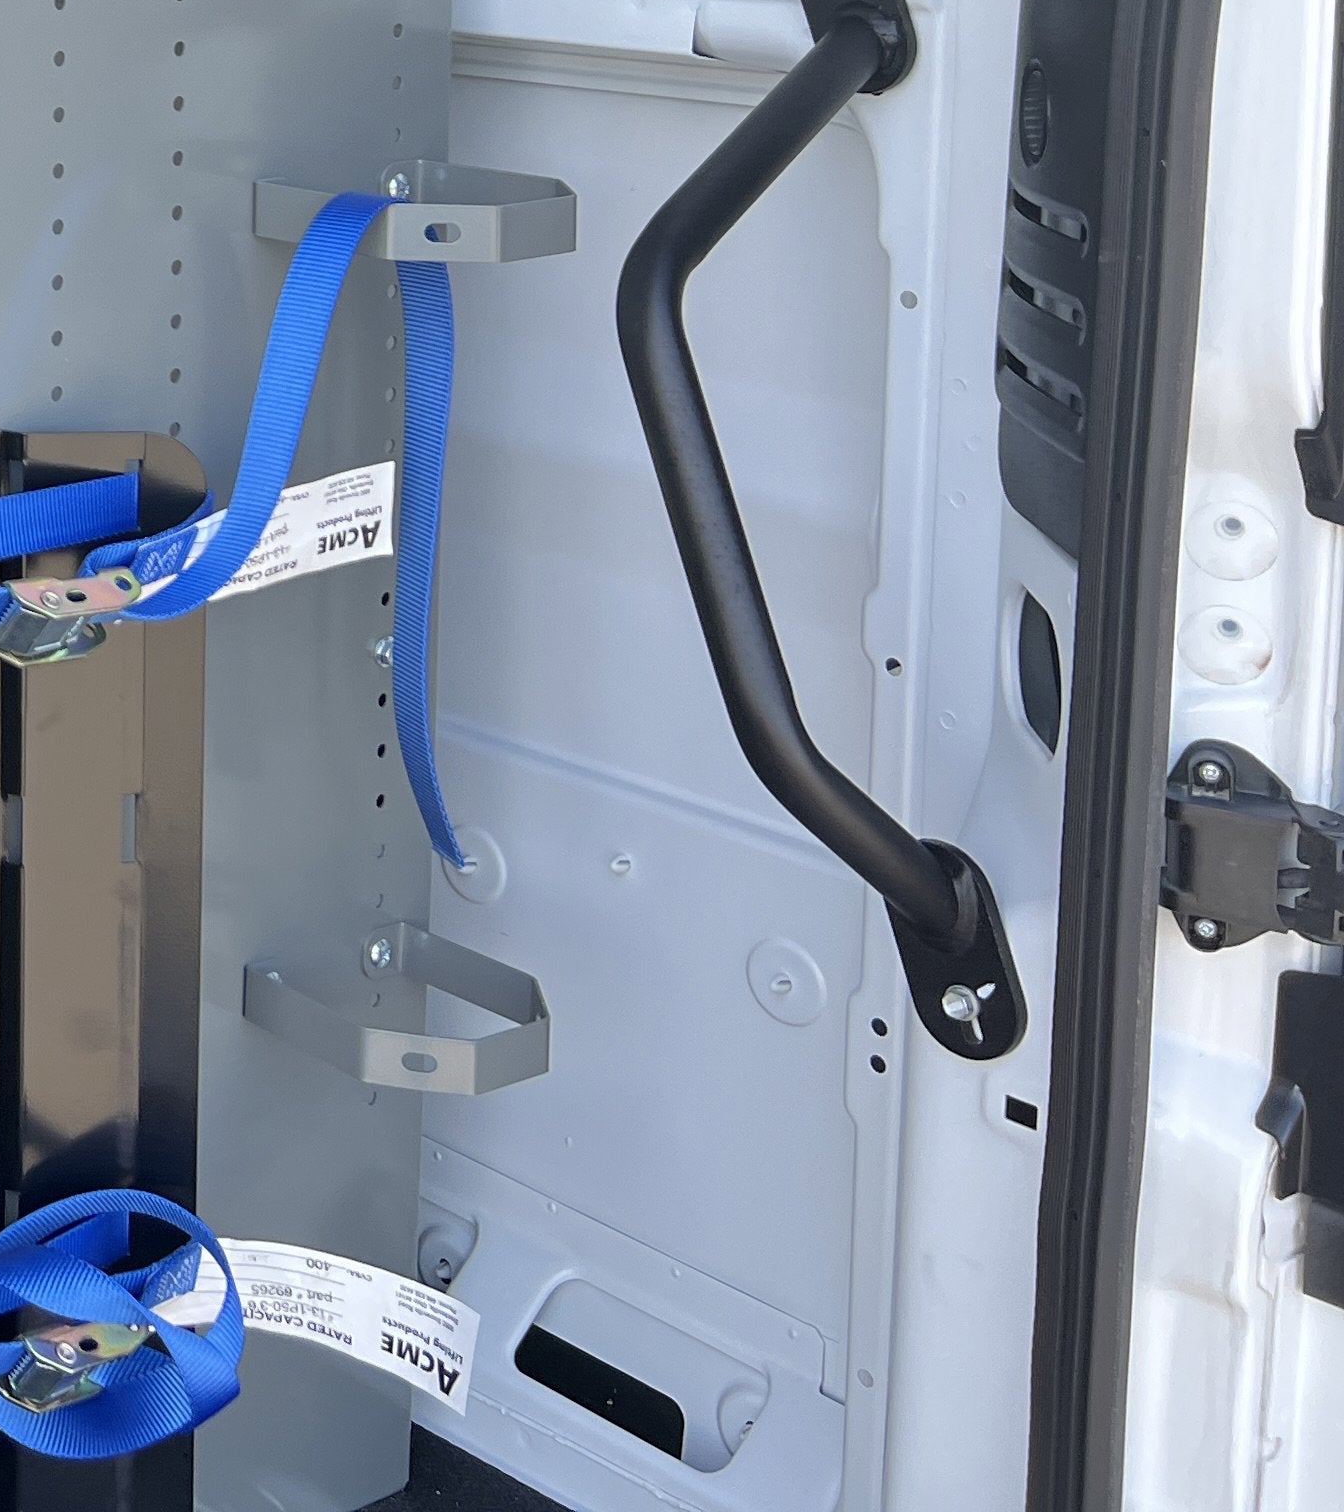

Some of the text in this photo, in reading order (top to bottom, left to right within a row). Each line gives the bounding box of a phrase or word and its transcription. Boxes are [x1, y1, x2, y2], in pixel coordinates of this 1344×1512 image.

[317, 505, 382, 528] Lifting Products
[317, 519, 381, 555] ACME
[264, 559, 298, 577] RATED
[307, 1289, 332, 1302] part
[307, 1320, 352, 1346] RATED
[382, 1316, 430, 1345] Products
[380, 1331, 461, 1396] ACME
[433, 1338, 463, 1365] Lifting
